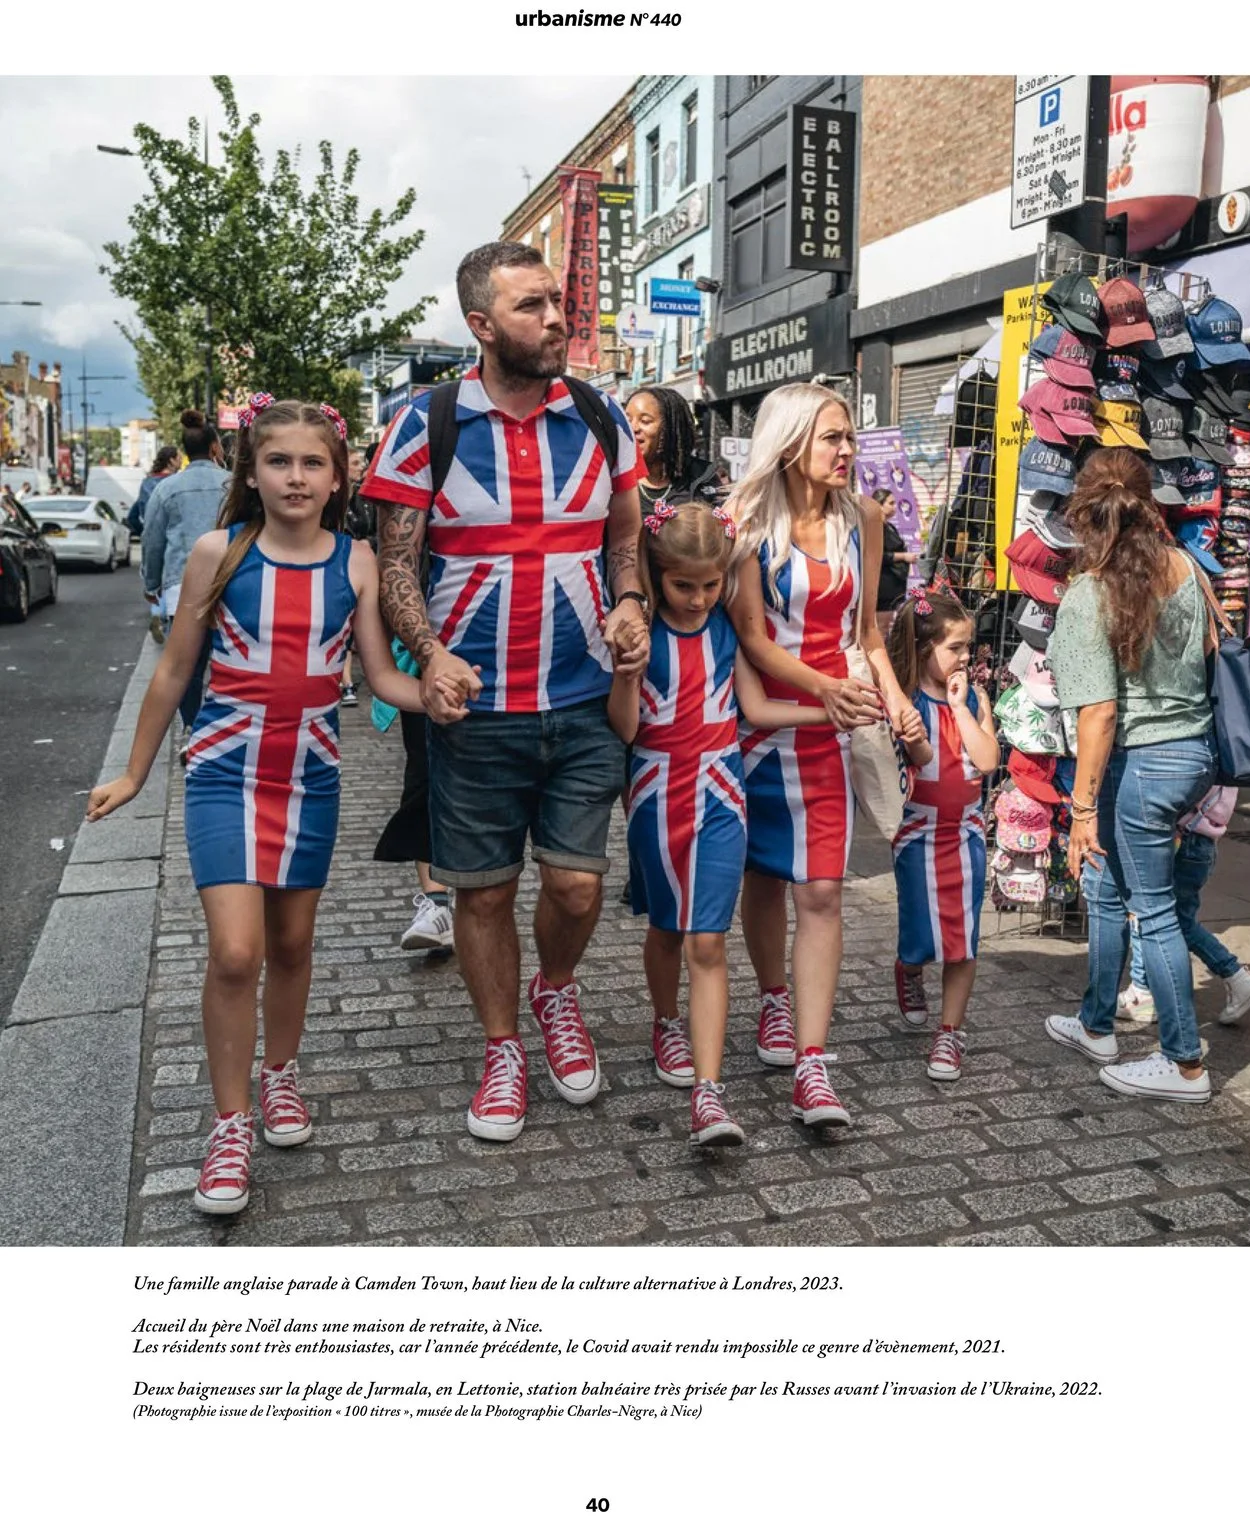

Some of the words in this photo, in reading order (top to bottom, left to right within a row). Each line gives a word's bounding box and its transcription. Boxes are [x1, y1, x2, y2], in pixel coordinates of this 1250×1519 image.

[1044, 93, 1057, 123] P
[1033, 134, 1049, 146] Mon
[1055, 124, 1065, 137] Fri
[1070, 135, 1081, 146] am
[800, 116, 817, 256] ELECTRIC
[822, 120, 841, 258] BALLROOM
[1029, 177, 1041, 190] Sat
[577, 203, 594, 340] PIERCING
[598, 208, 613, 311] TATTOO
[652, 301, 699, 311] EXCHANGE
[731, 316, 808, 362] ELECTRIC
[726, 348, 813, 392] BALLROOM
